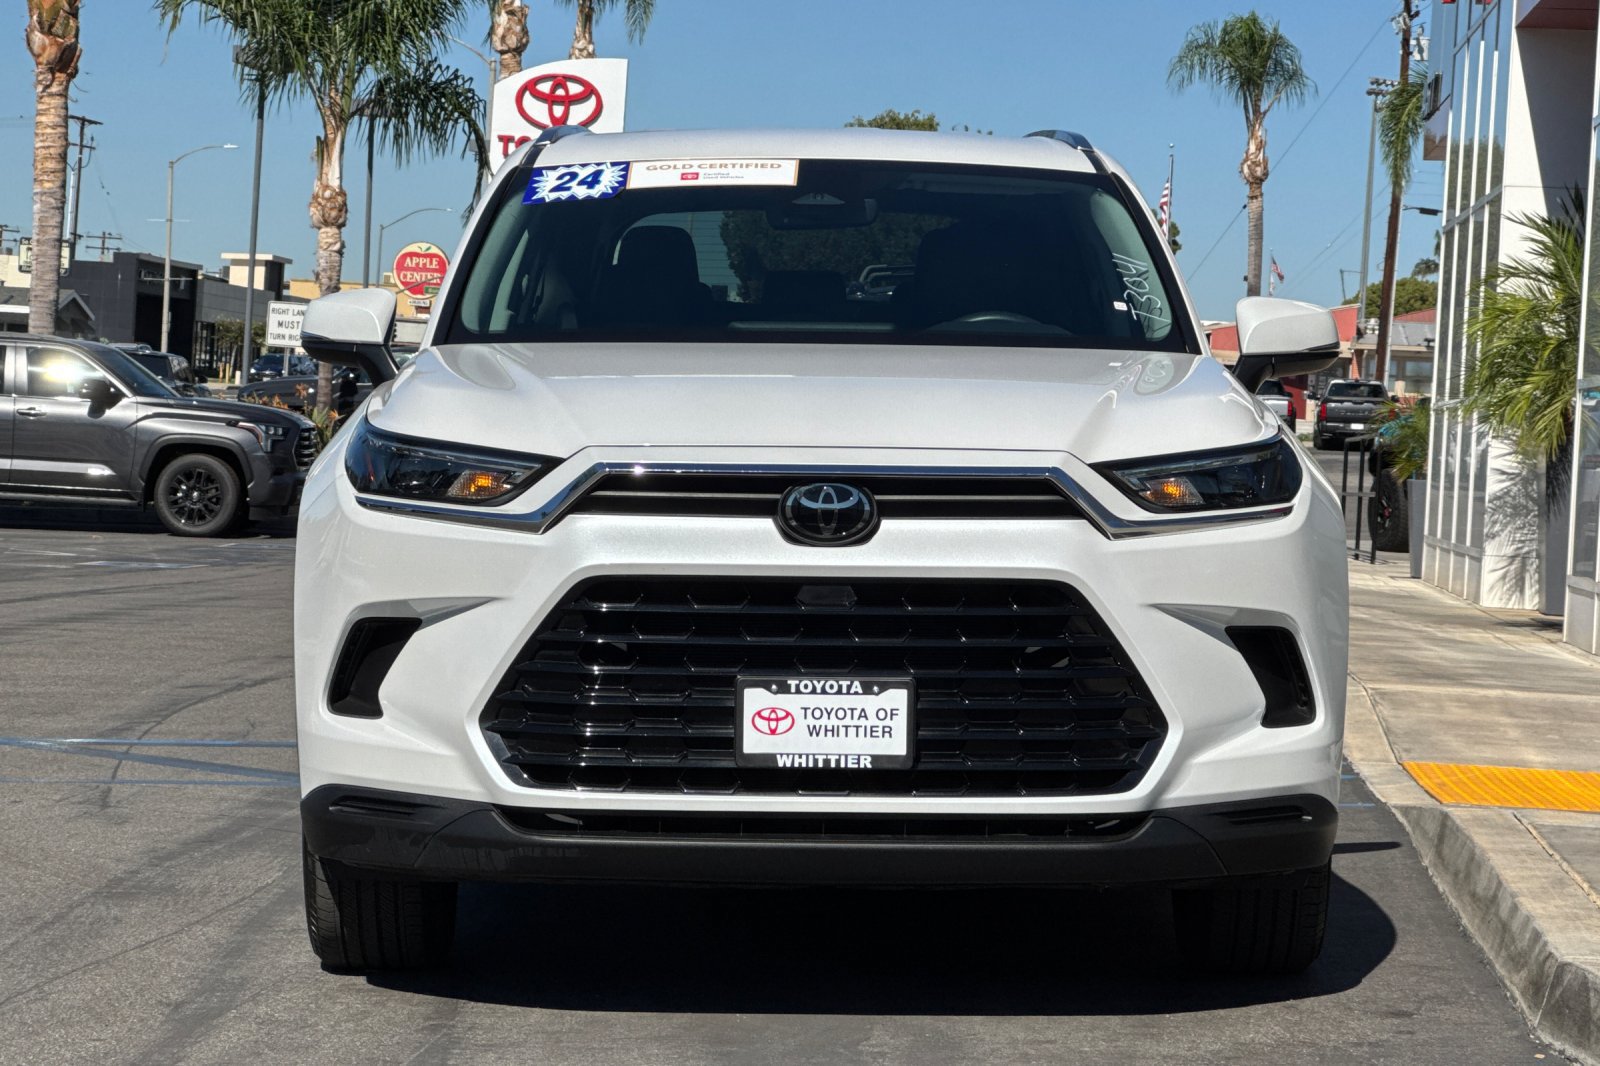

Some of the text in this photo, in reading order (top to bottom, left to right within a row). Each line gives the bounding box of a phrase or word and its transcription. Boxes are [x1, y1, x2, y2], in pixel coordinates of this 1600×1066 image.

[646, 161, 782, 171] GOLD CERTIFIED
[548, 169, 605, 193] 24
[404, 256, 440, 269] APPLE
[400, 271, 441, 284] CENTER
[271, 307, 305, 317] RIGHT LAN
[277, 320, 301, 330] MUST
[269, 332, 302, 342] TURN RIG
[787, 680, 863, 694] TOYOTA
[800, 706, 900, 721] TOYOTA OF
[807, 724, 893, 739] WHITTIER
[776, 754, 873, 769] WHITTIER
